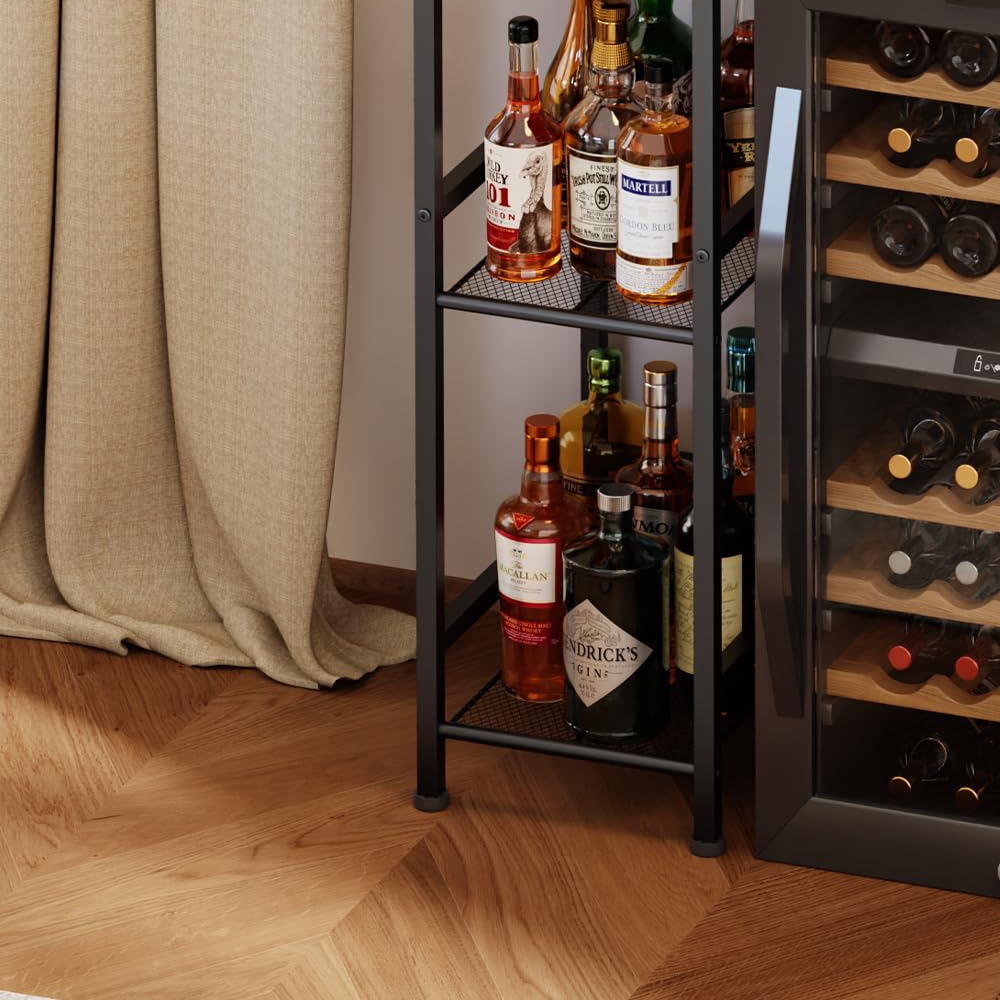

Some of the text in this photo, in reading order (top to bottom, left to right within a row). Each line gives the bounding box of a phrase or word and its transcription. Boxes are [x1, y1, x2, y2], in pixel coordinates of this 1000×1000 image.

[590, 164, 614, 173] FINEST
[622, 177, 668, 194] MARTELL
[652, 222, 675, 232] BLEU
[564, 637, 639, 663] ENDRICK'S
